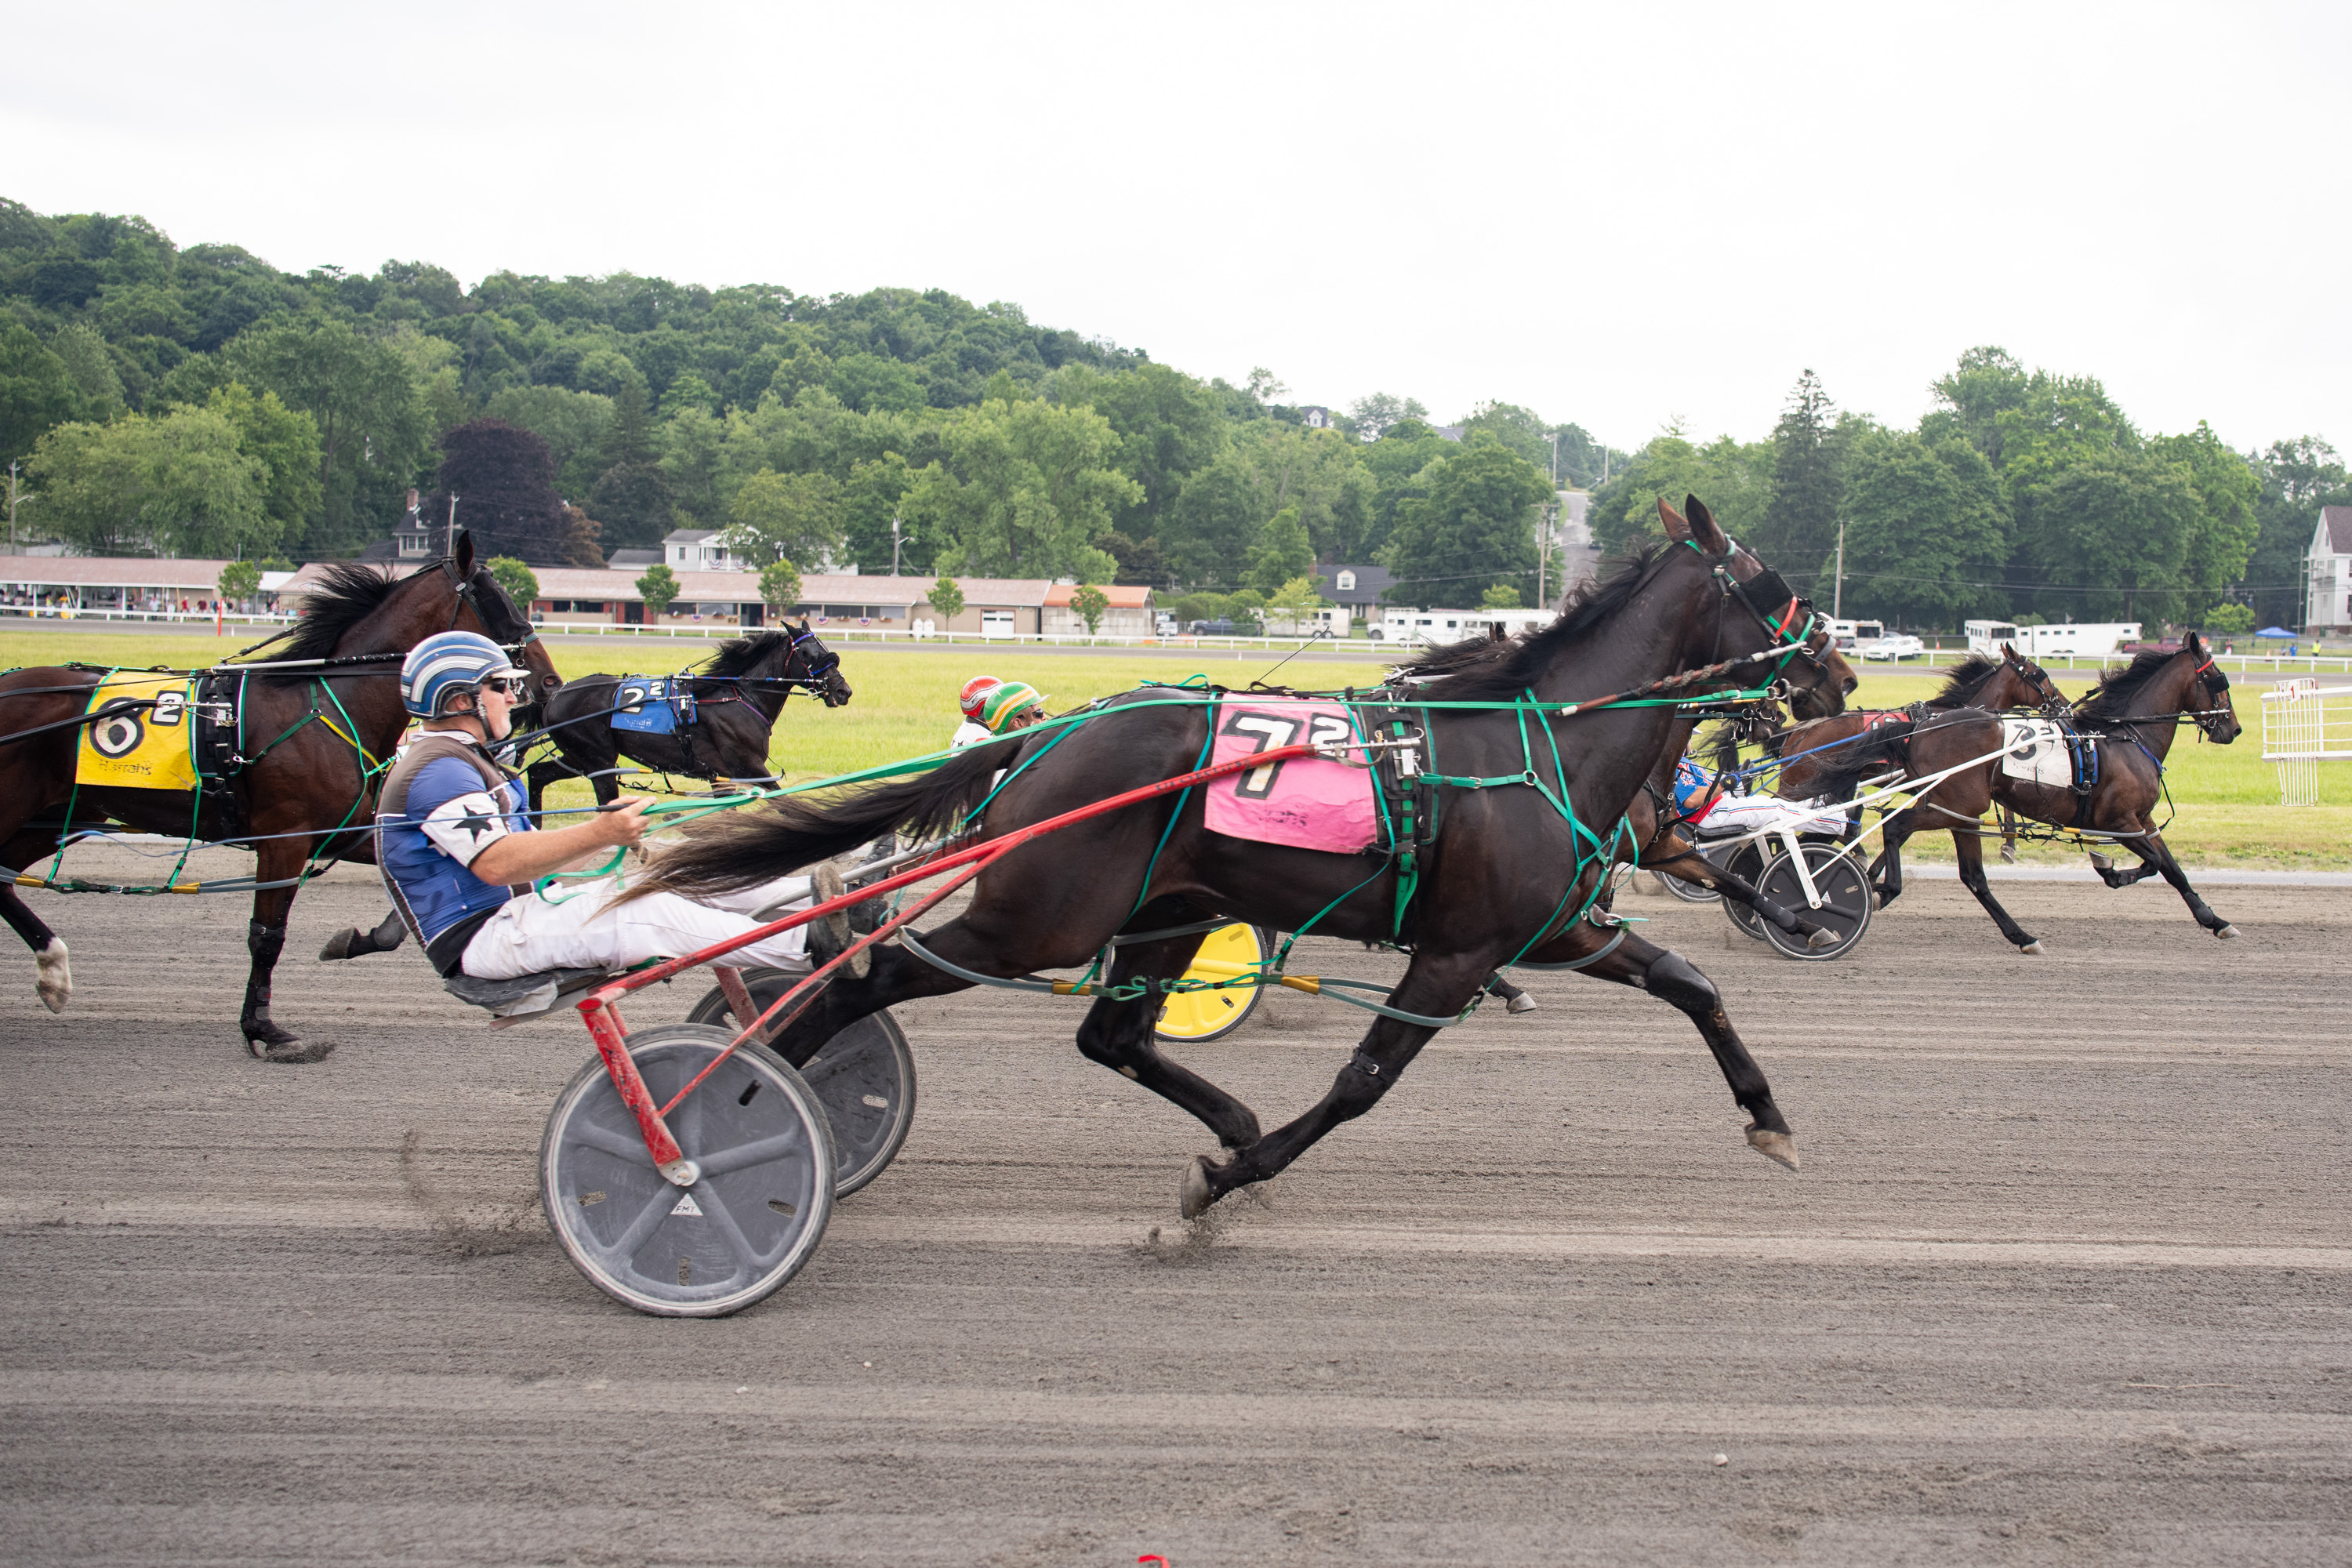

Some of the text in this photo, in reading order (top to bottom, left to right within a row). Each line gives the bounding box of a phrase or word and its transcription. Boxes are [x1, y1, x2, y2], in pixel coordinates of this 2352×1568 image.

[620, 681, 666, 714] 2 2
[2290, 685, 2295, 699] 1
[91, 691, 186, 757] 6 2
[2009, 724, 2037, 760] 3
[1225, 713, 1351, 797] 7 2
